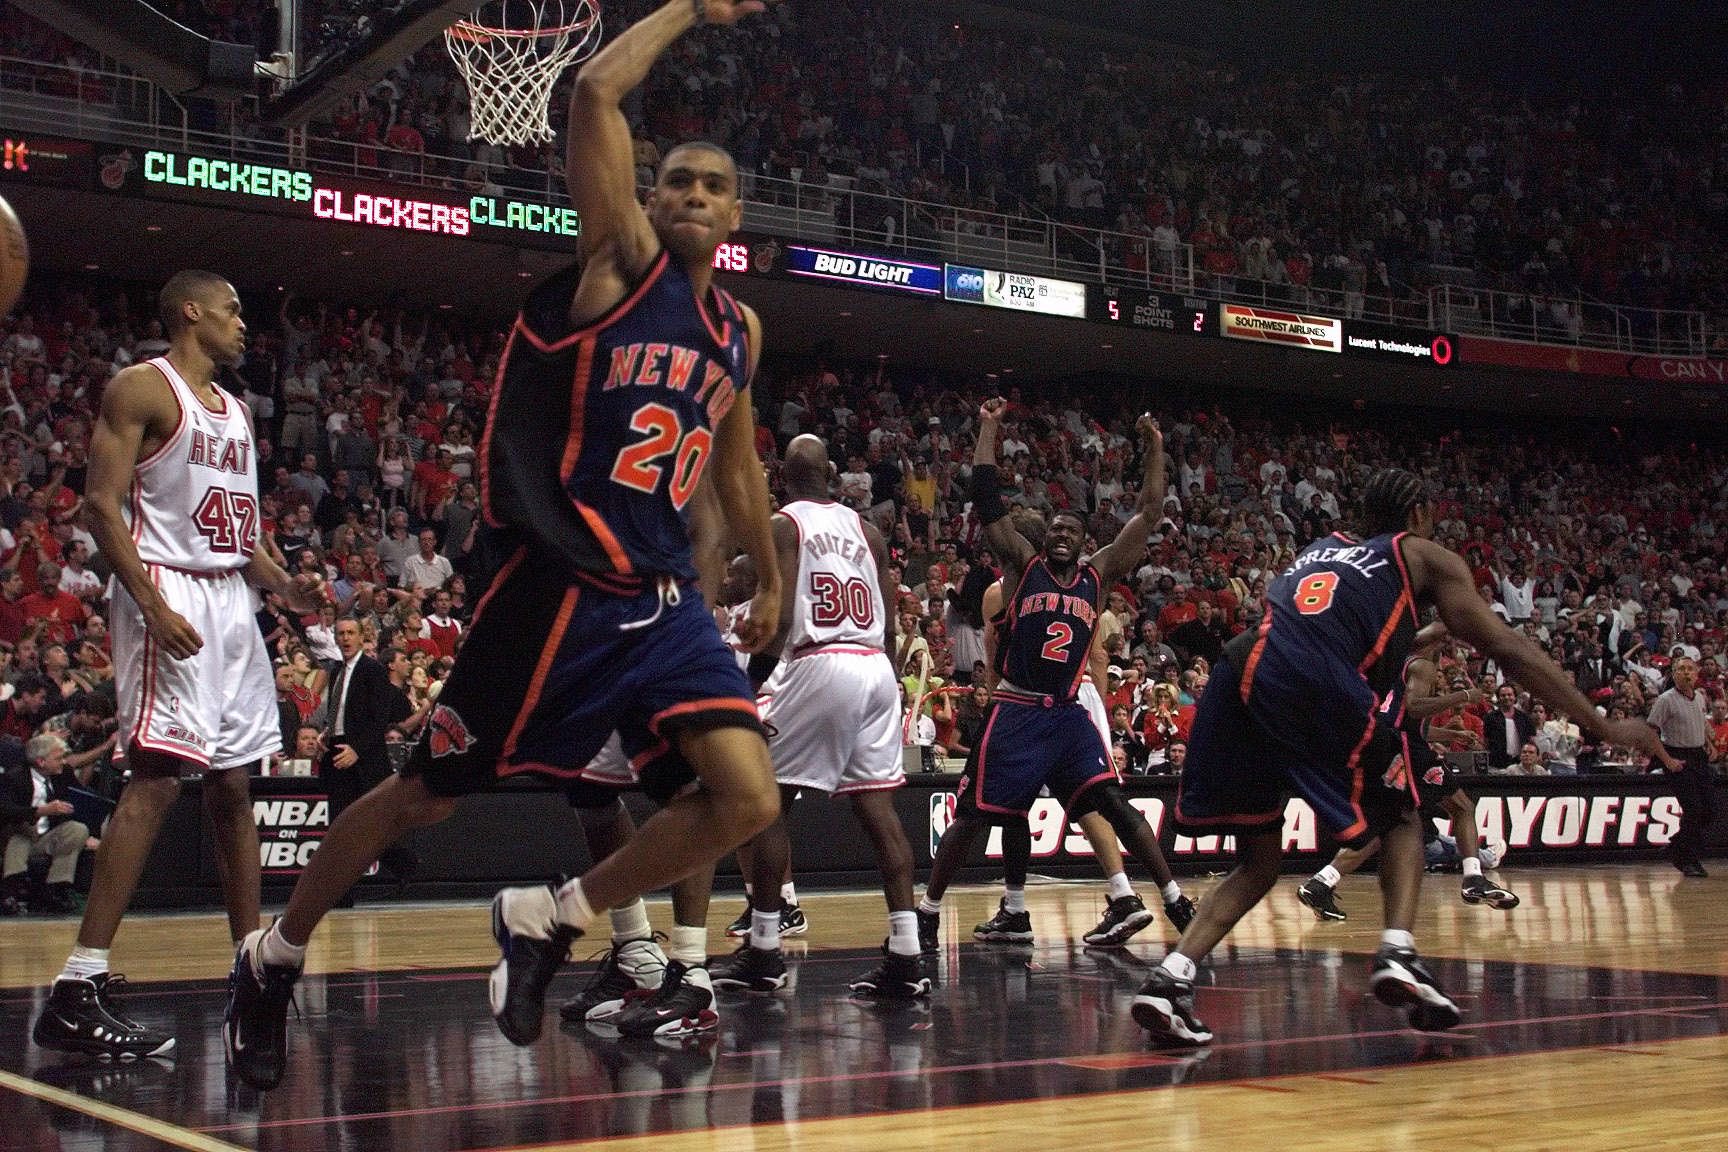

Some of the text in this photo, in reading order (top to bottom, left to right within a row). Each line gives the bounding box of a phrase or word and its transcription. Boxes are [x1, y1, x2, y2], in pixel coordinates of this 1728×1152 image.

[144, 150, 582, 236] CLACKERS CLACKERS CLACKE
[814, 253, 914, 283] BUD LIGHT
[1009, 275, 1036, 287] RADIO
[1010, 285, 1035, 299] PAZ
[1108, 300, 1119, 320] 5
[1133, 315, 1174, 329] SHOTS
[1135, 305, 1173, 318] POINT
[1193, 312, 1204, 332] 2
[1235, 315, 1326, 337] SOUTHWEST AIRLINES
[1348, 335, 1431, 357] Lucent Technologies
[602, 342, 700, 391] NEW
[187, 428, 251, 476] HEAT
[609, 401, 714, 512] 20
[191, 485, 257, 559] 42
[810, 571, 875, 630] 30
[1018, 591, 1060, 618] NEW
[1293, 570, 1340, 615] 8
[1041, 621, 1073, 664] 2
[253, 800, 330, 826] NBA
[1432, 796, 1683, 849] AYOFFS
[278, 829, 299, 839] ON
